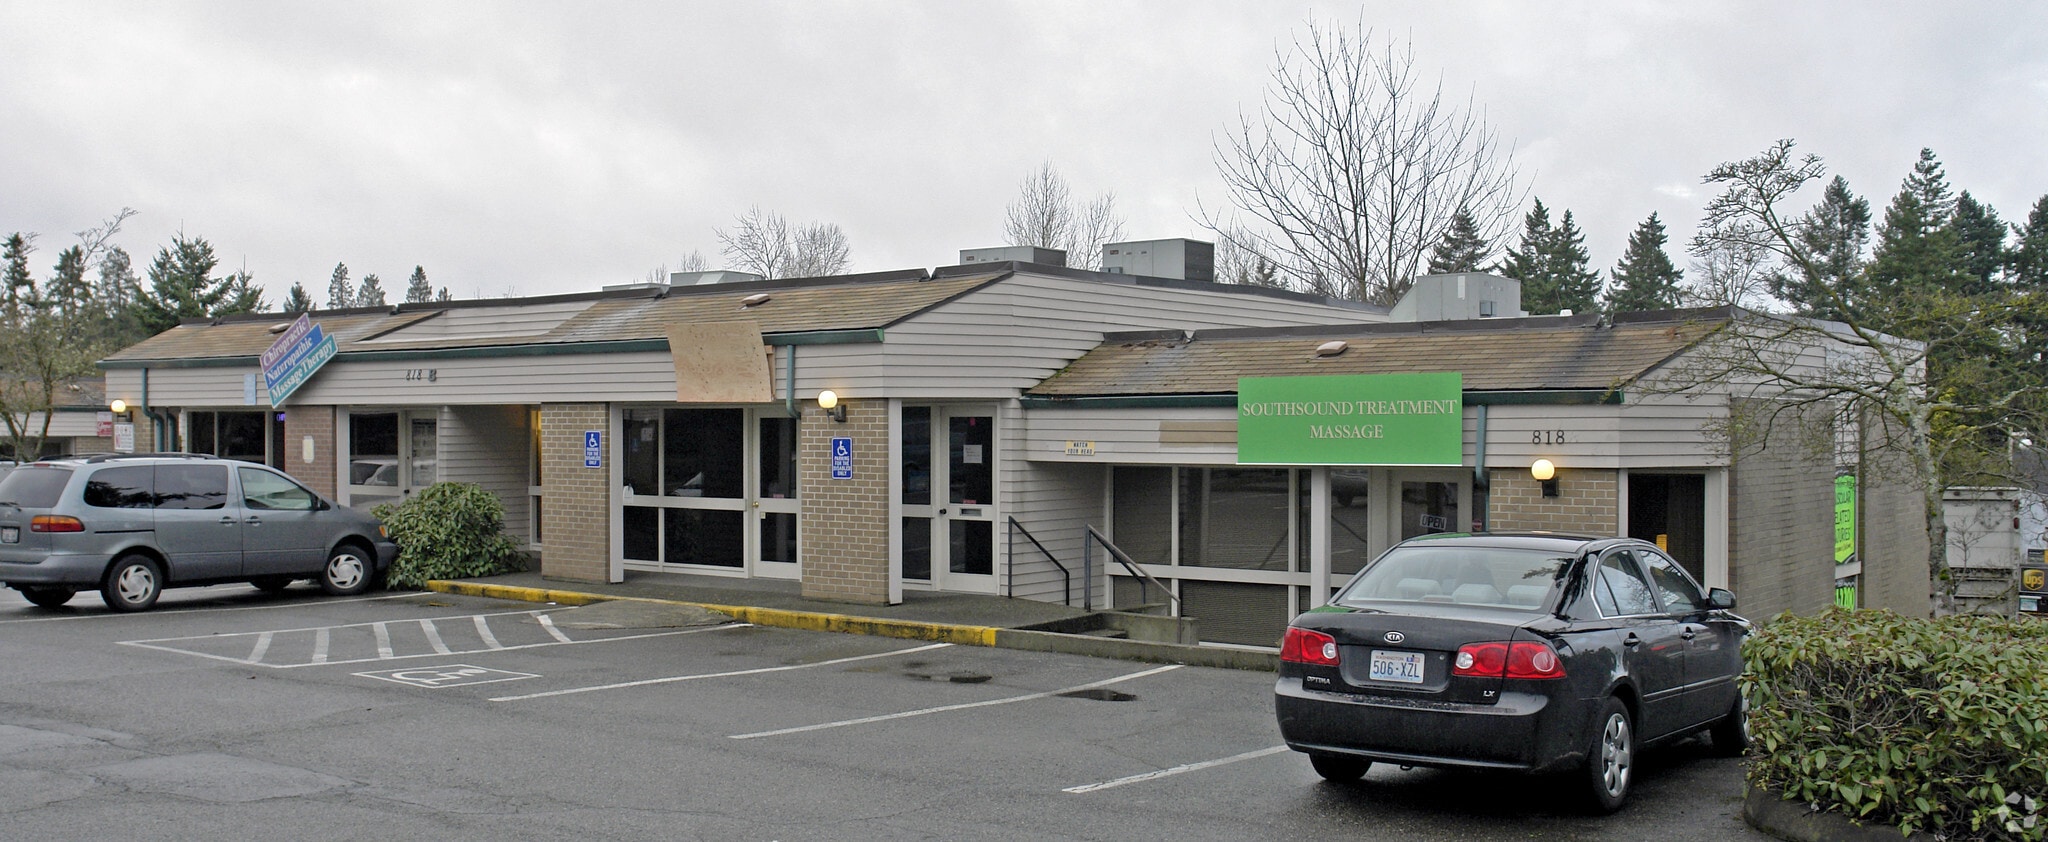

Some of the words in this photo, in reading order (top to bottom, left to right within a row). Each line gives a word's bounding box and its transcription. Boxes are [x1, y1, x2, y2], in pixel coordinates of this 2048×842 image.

[263, 322, 307, 366] Chiropractic
[266, 337, 312, 385] Naturopathic
[271, 368, 303, 401] Massage
[301, 340, 332, 373] Therapy
[406, 369, 422, 381] 818
[1242, 402, 1354, 416] SOUTHSOUND
[1356, 400, 1458, 415] TREATMENT
[1310, 425, 1384, 439] MASSAGE
[1532, 430, 1565, 445] 818
[1421, 515, 1446, 529] OPEN
[2025, 576, 2043, 588] ups
[1306, 675, 1331, 685] OPTIMA
[1482, 690, 1496, 698] LX
